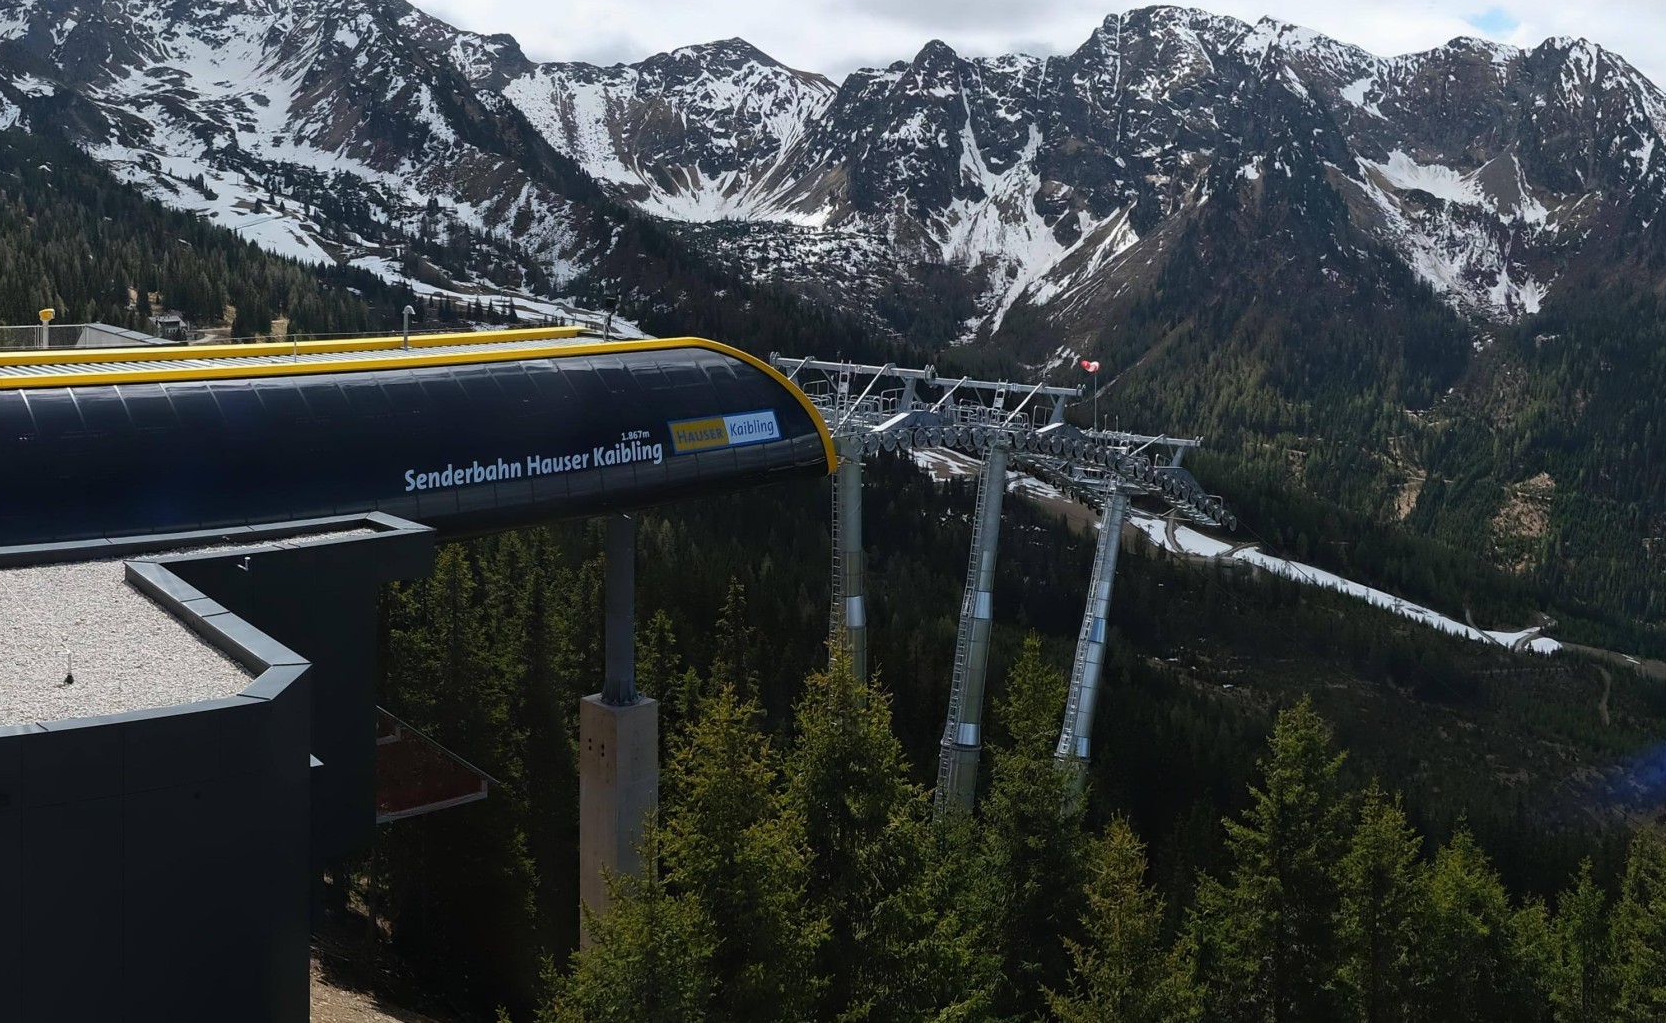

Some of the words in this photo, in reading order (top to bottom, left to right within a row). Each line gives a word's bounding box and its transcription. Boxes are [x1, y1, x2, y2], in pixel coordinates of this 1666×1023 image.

[621, 430, 650, 441] 1.867m
[677, 428, 724, 444] HAUSER
[730, 420, 774, 437] Kaibling
[404, 457, 522, 492] Senderbahn
[526, 451, 590, 476] Hauser
[592, 440, 663, 466] Kaibling
